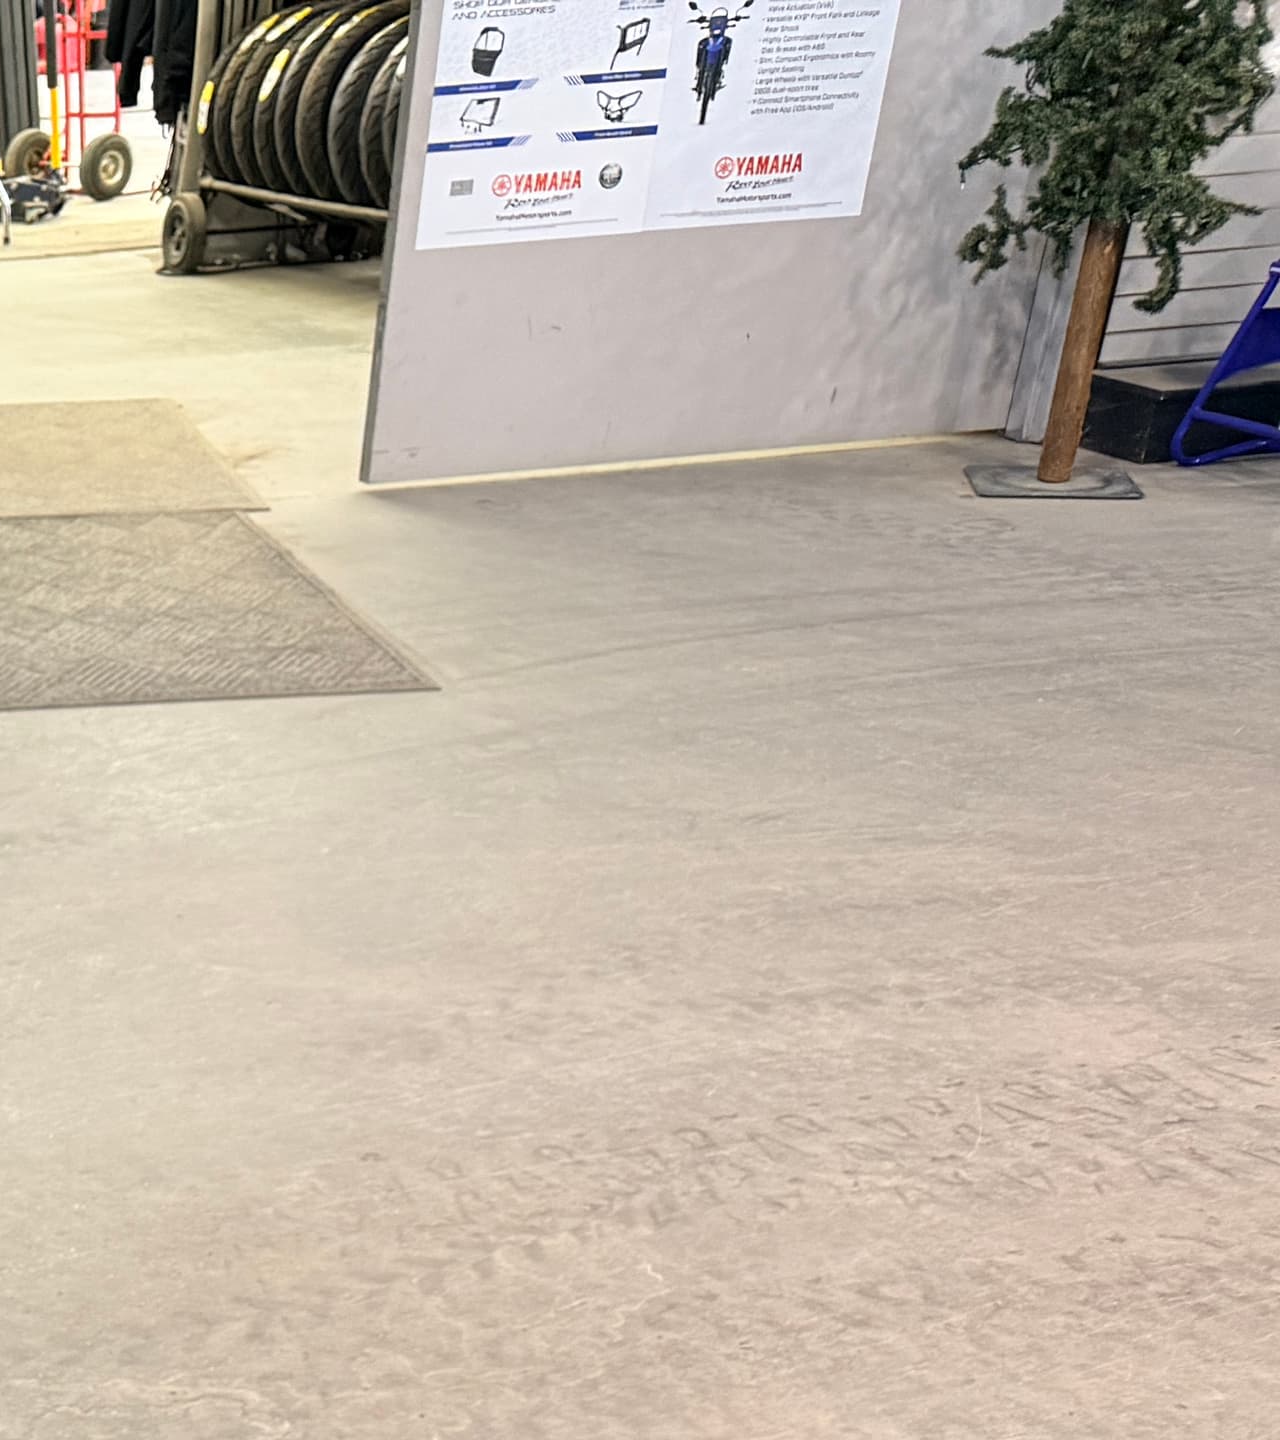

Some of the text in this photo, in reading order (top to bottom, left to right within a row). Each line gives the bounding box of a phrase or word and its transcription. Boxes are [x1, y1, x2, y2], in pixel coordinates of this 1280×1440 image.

[480, 5, 556, 19] ACCESSORIES
[736, 153, 803, 176] YAMAHA
[514, 169, 582, 193] YAMAHA
[716, 192, 792, 204] YamahaMotorsports.com
